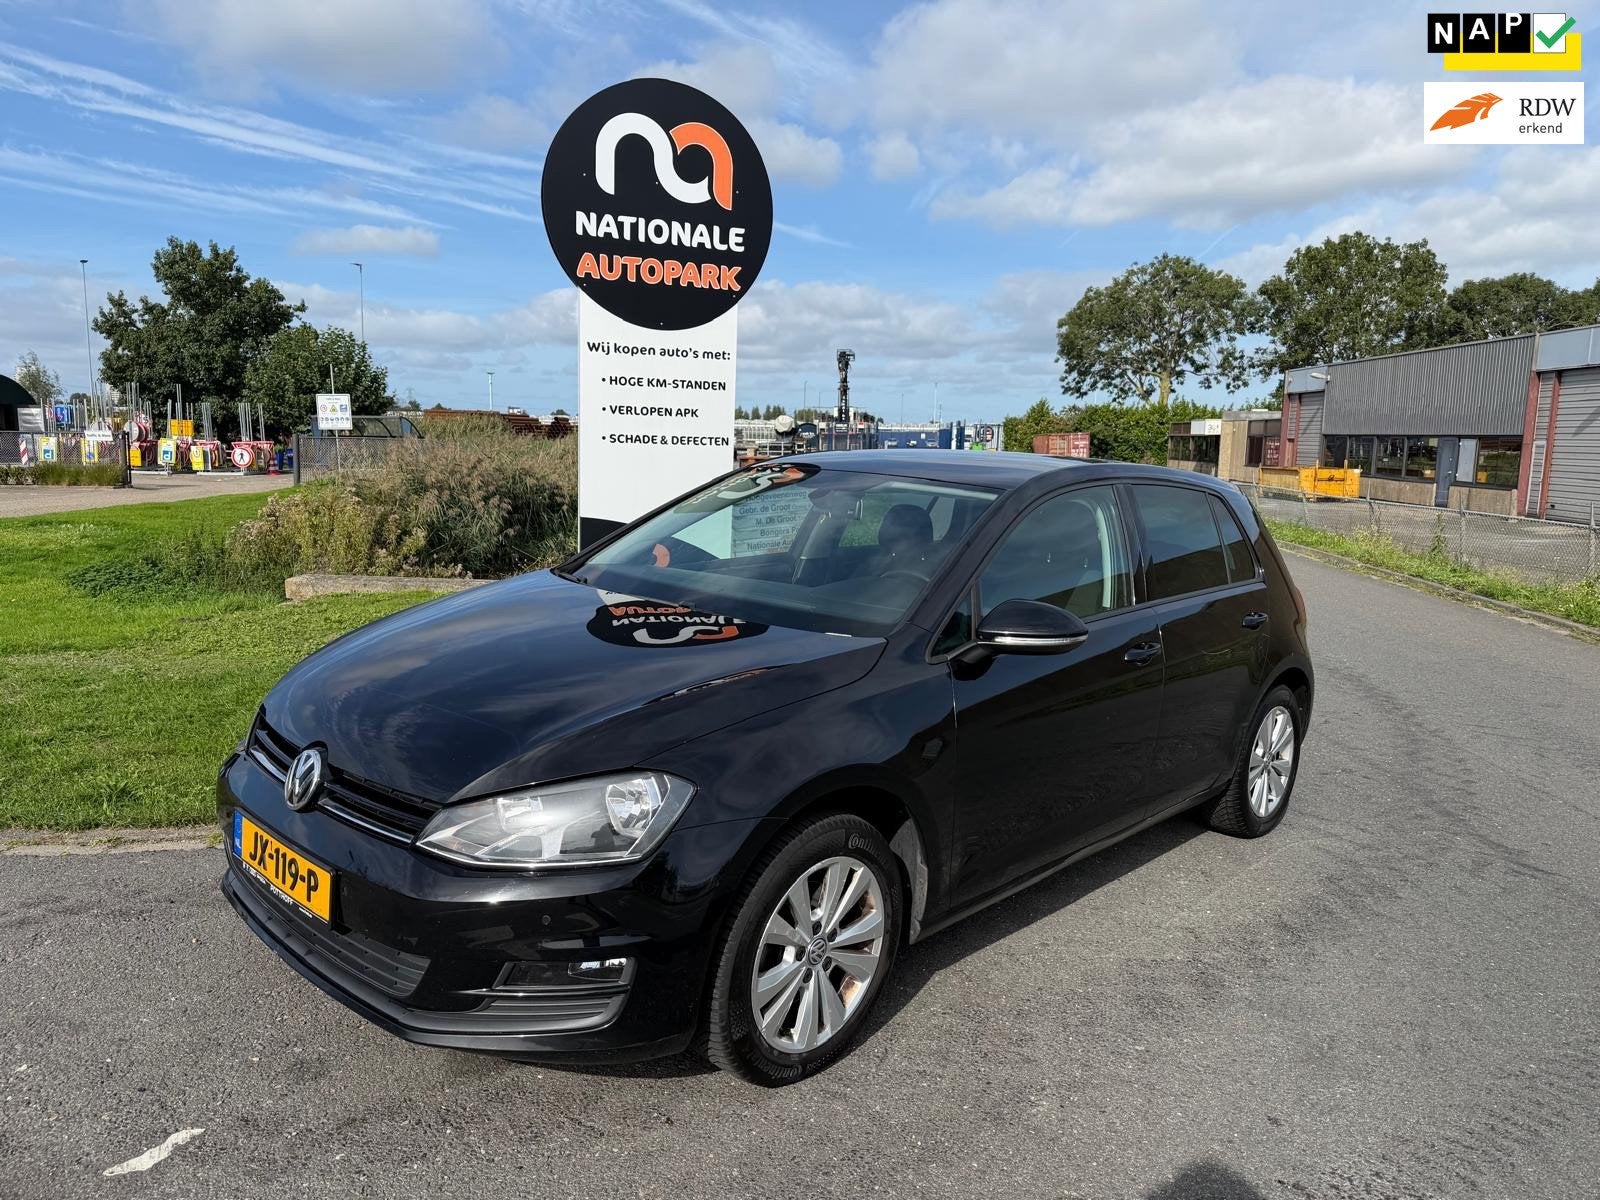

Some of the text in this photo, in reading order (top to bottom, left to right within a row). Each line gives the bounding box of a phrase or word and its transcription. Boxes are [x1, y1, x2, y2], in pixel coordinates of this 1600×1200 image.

[575, 210, 746, 253] NATIONALE
[576, 252, 743, 292] AUTOPARK
[586, 341, 731, 361] Wij kopen auto's met:
[609, 376, 727, 391] HOGE KM-STANDEN
[609, 405, 699, 418] VERLOPEN APK
[609, 433, 730, 447] SCHADE & DEFECTEN
[248, 831, 319, 904] JX-119-P
